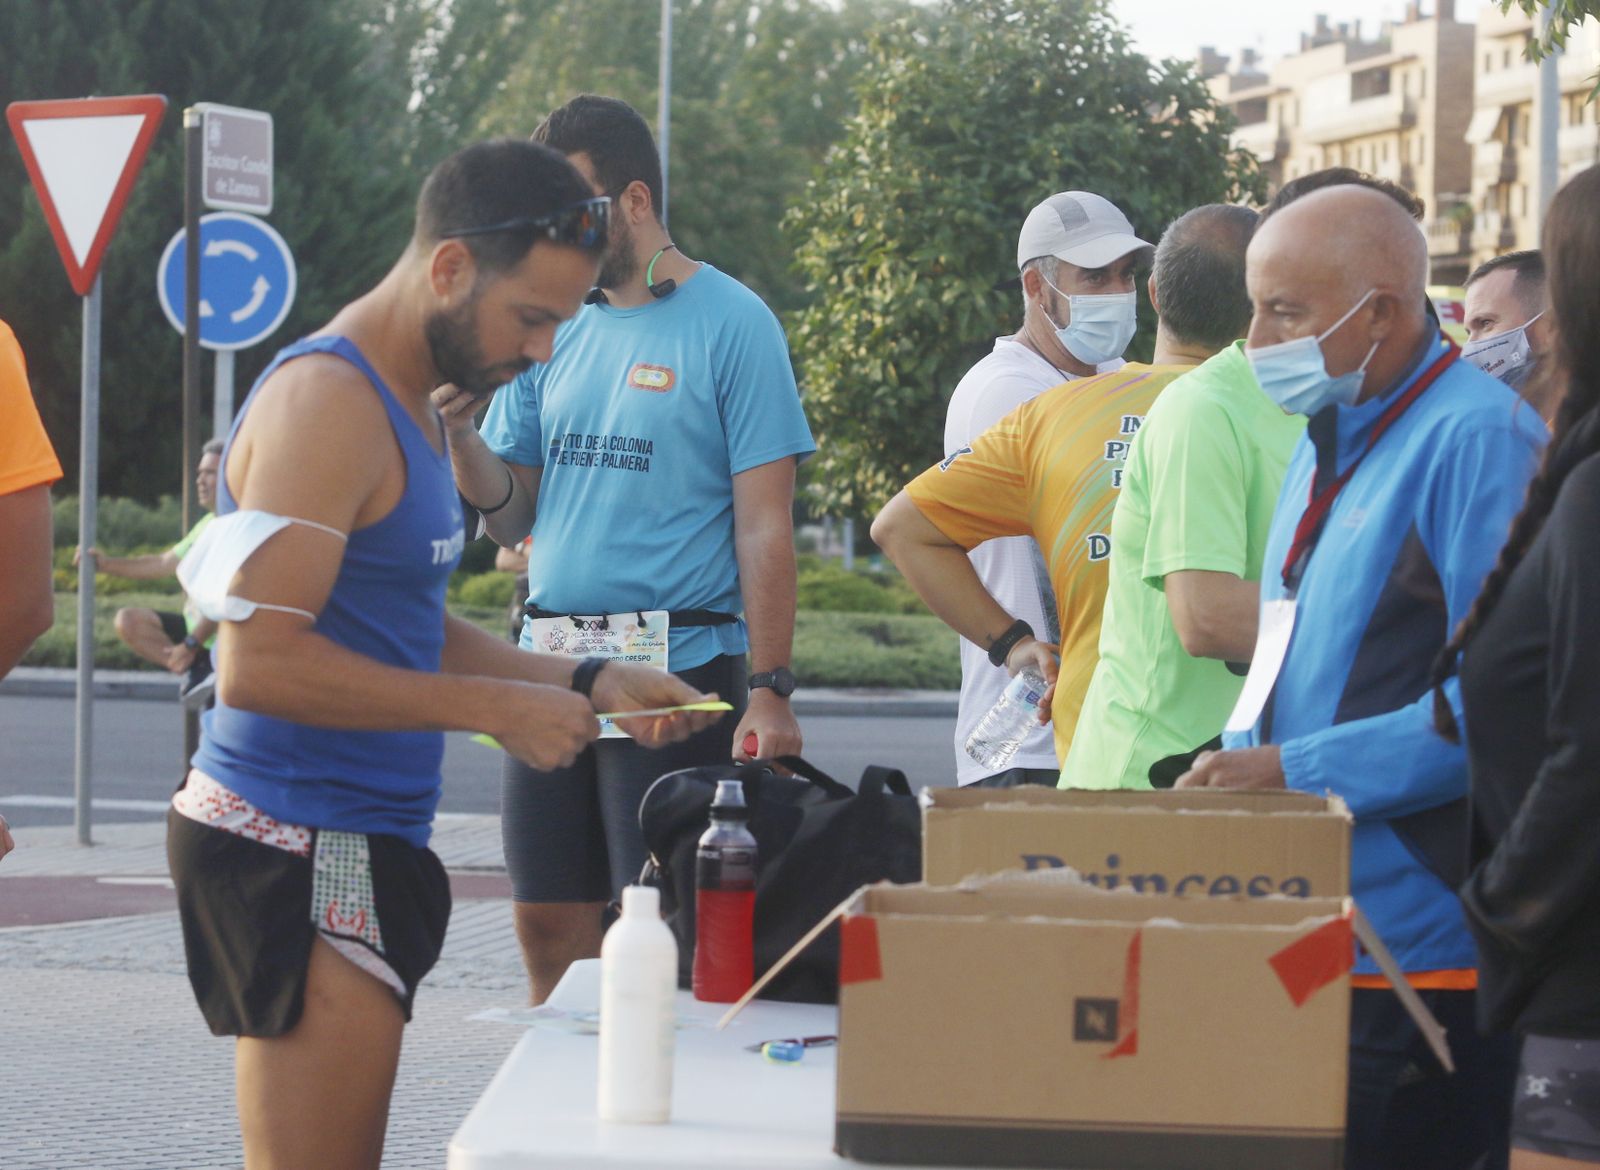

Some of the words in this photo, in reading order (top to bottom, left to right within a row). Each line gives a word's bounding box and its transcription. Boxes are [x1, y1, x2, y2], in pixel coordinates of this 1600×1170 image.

[610, 435, 653, 455] COLONIA
[601, 452, 650, 472] PALMERA
[1021, 854, 1312, 898] incesa
